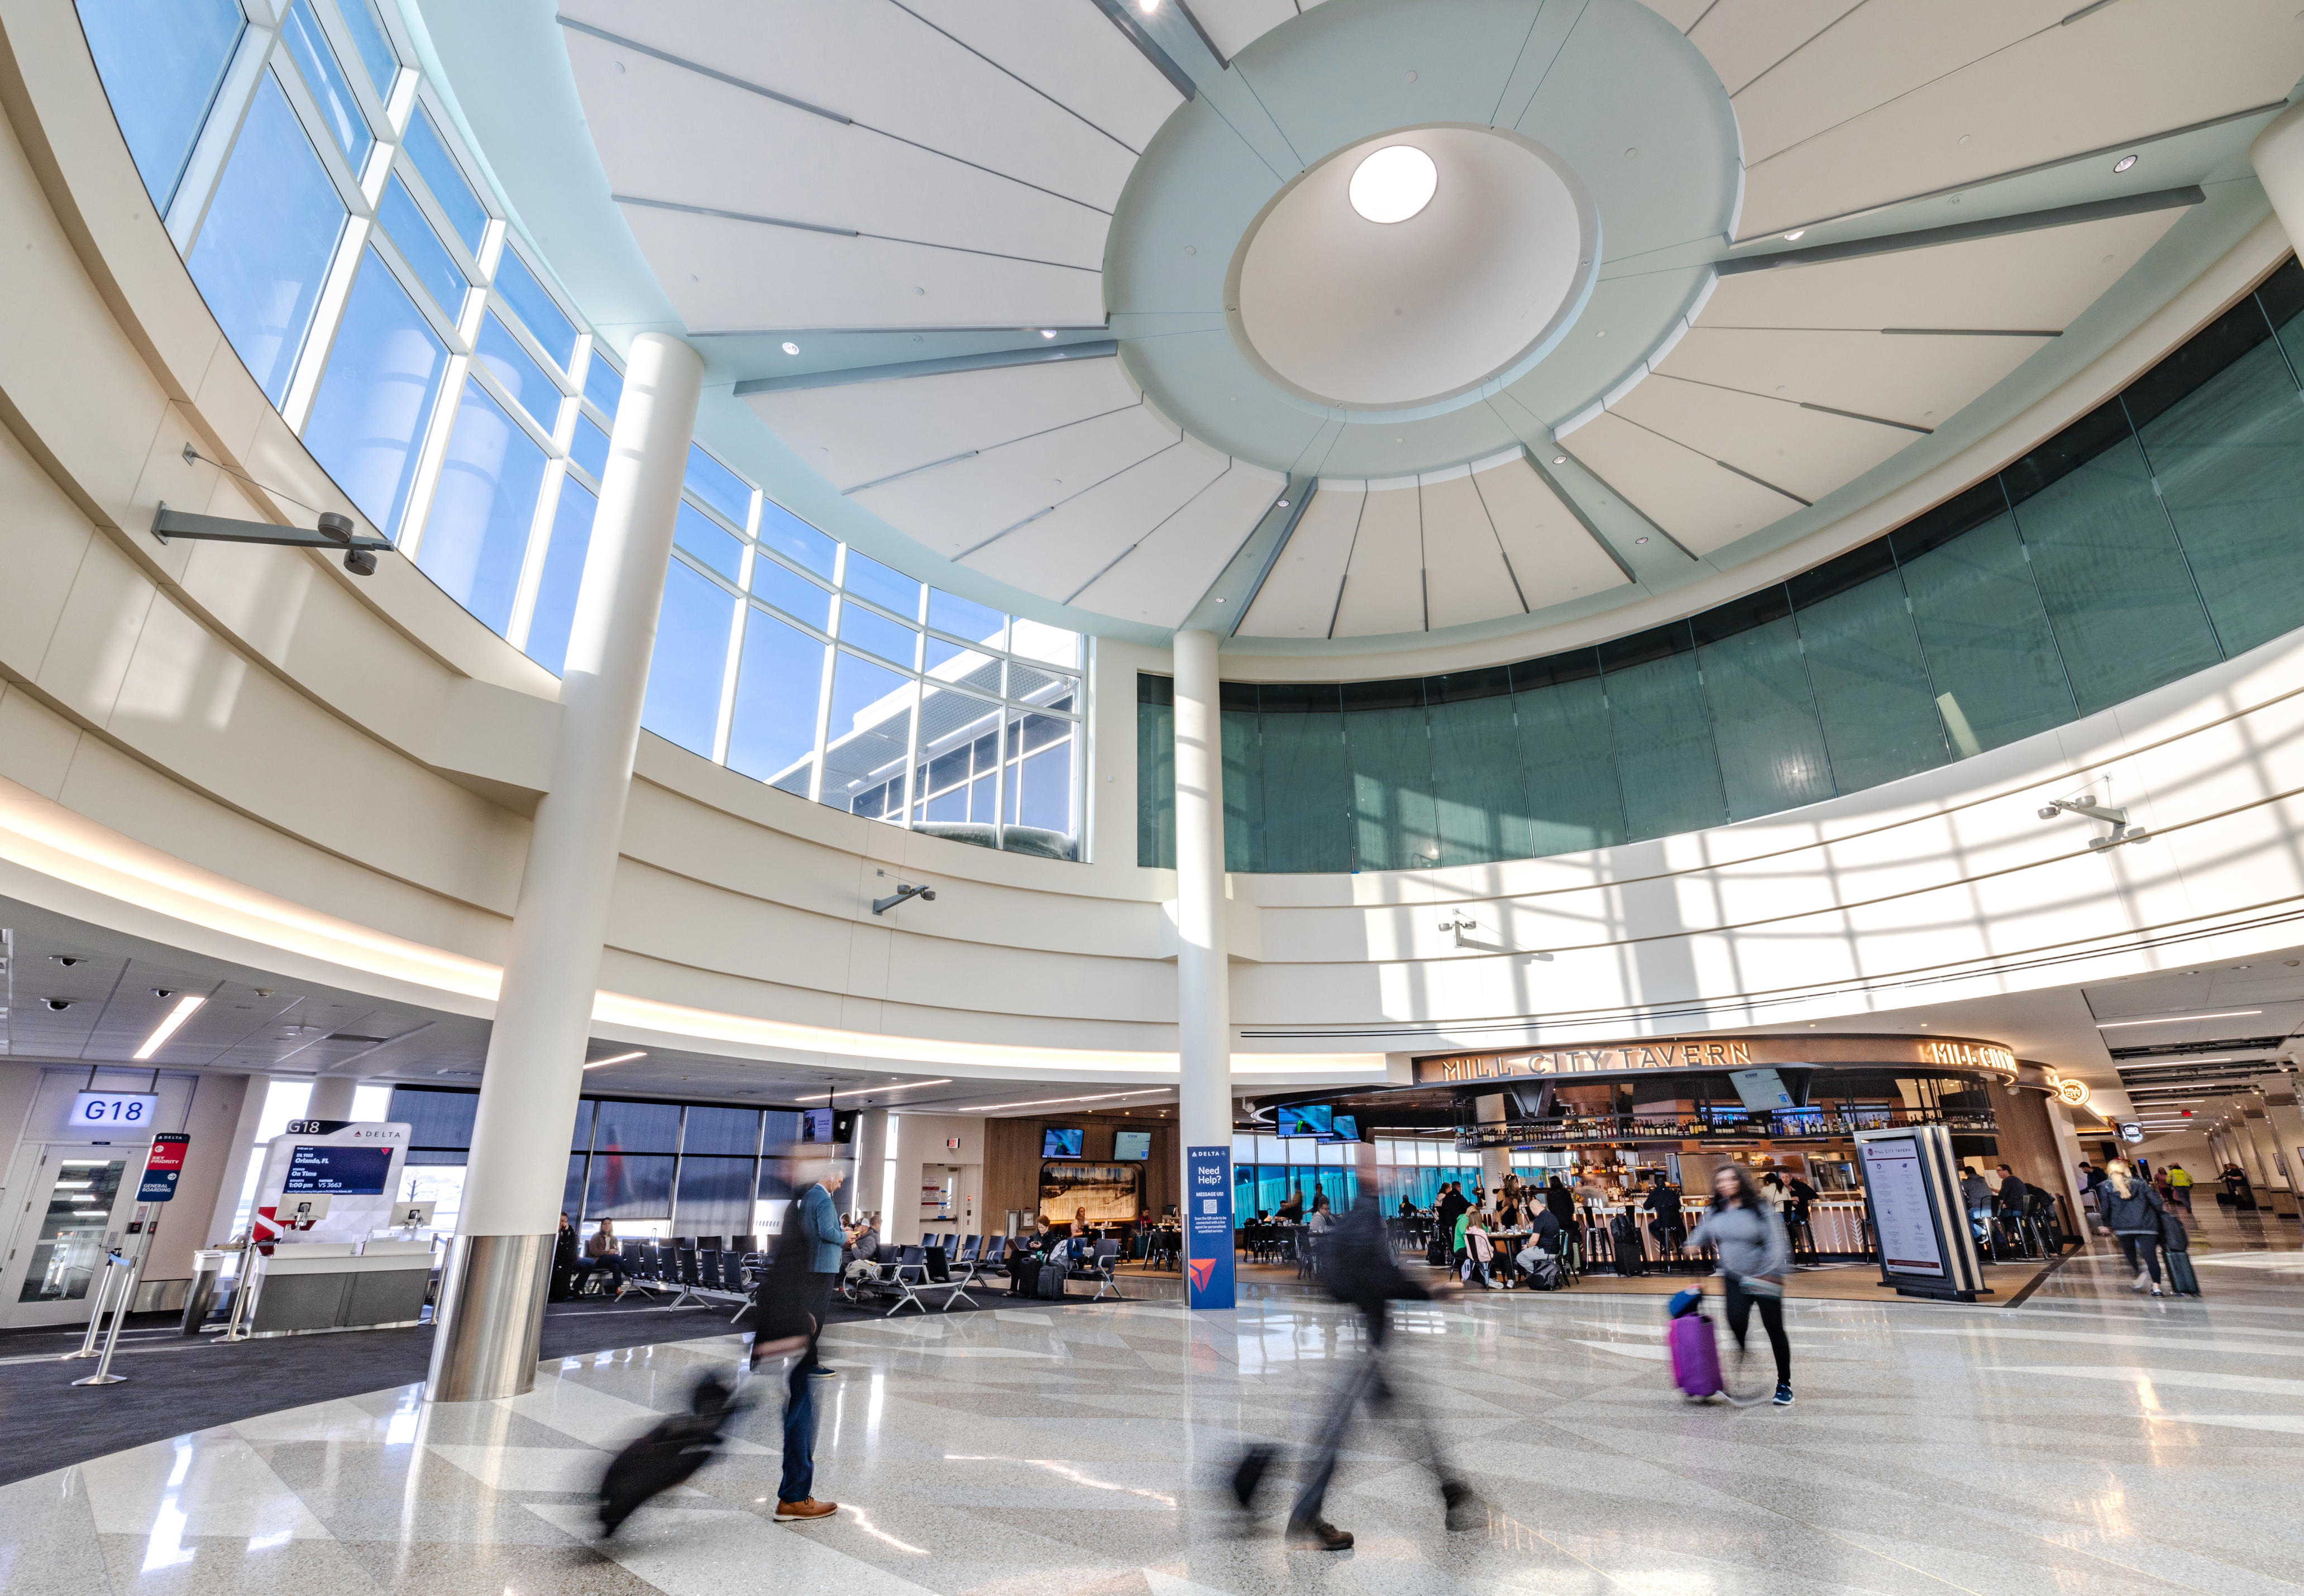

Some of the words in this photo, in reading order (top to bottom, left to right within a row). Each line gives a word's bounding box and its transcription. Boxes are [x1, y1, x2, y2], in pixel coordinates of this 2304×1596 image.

[1932, 1043, 1977, 1065] MILL
[1442, 1057, 1513, 1081] MILL
[1528, 1050, 1604, 1074] CITY
[1617, 1043, 1752, 1068] TAVERN
[85, 1101, 143, 1120] G18
[288, 1121, 320, 1133] G18
[1198, 1166, 1220, 1175] Need
[1198, 1175, 1221, 1185] Help?
